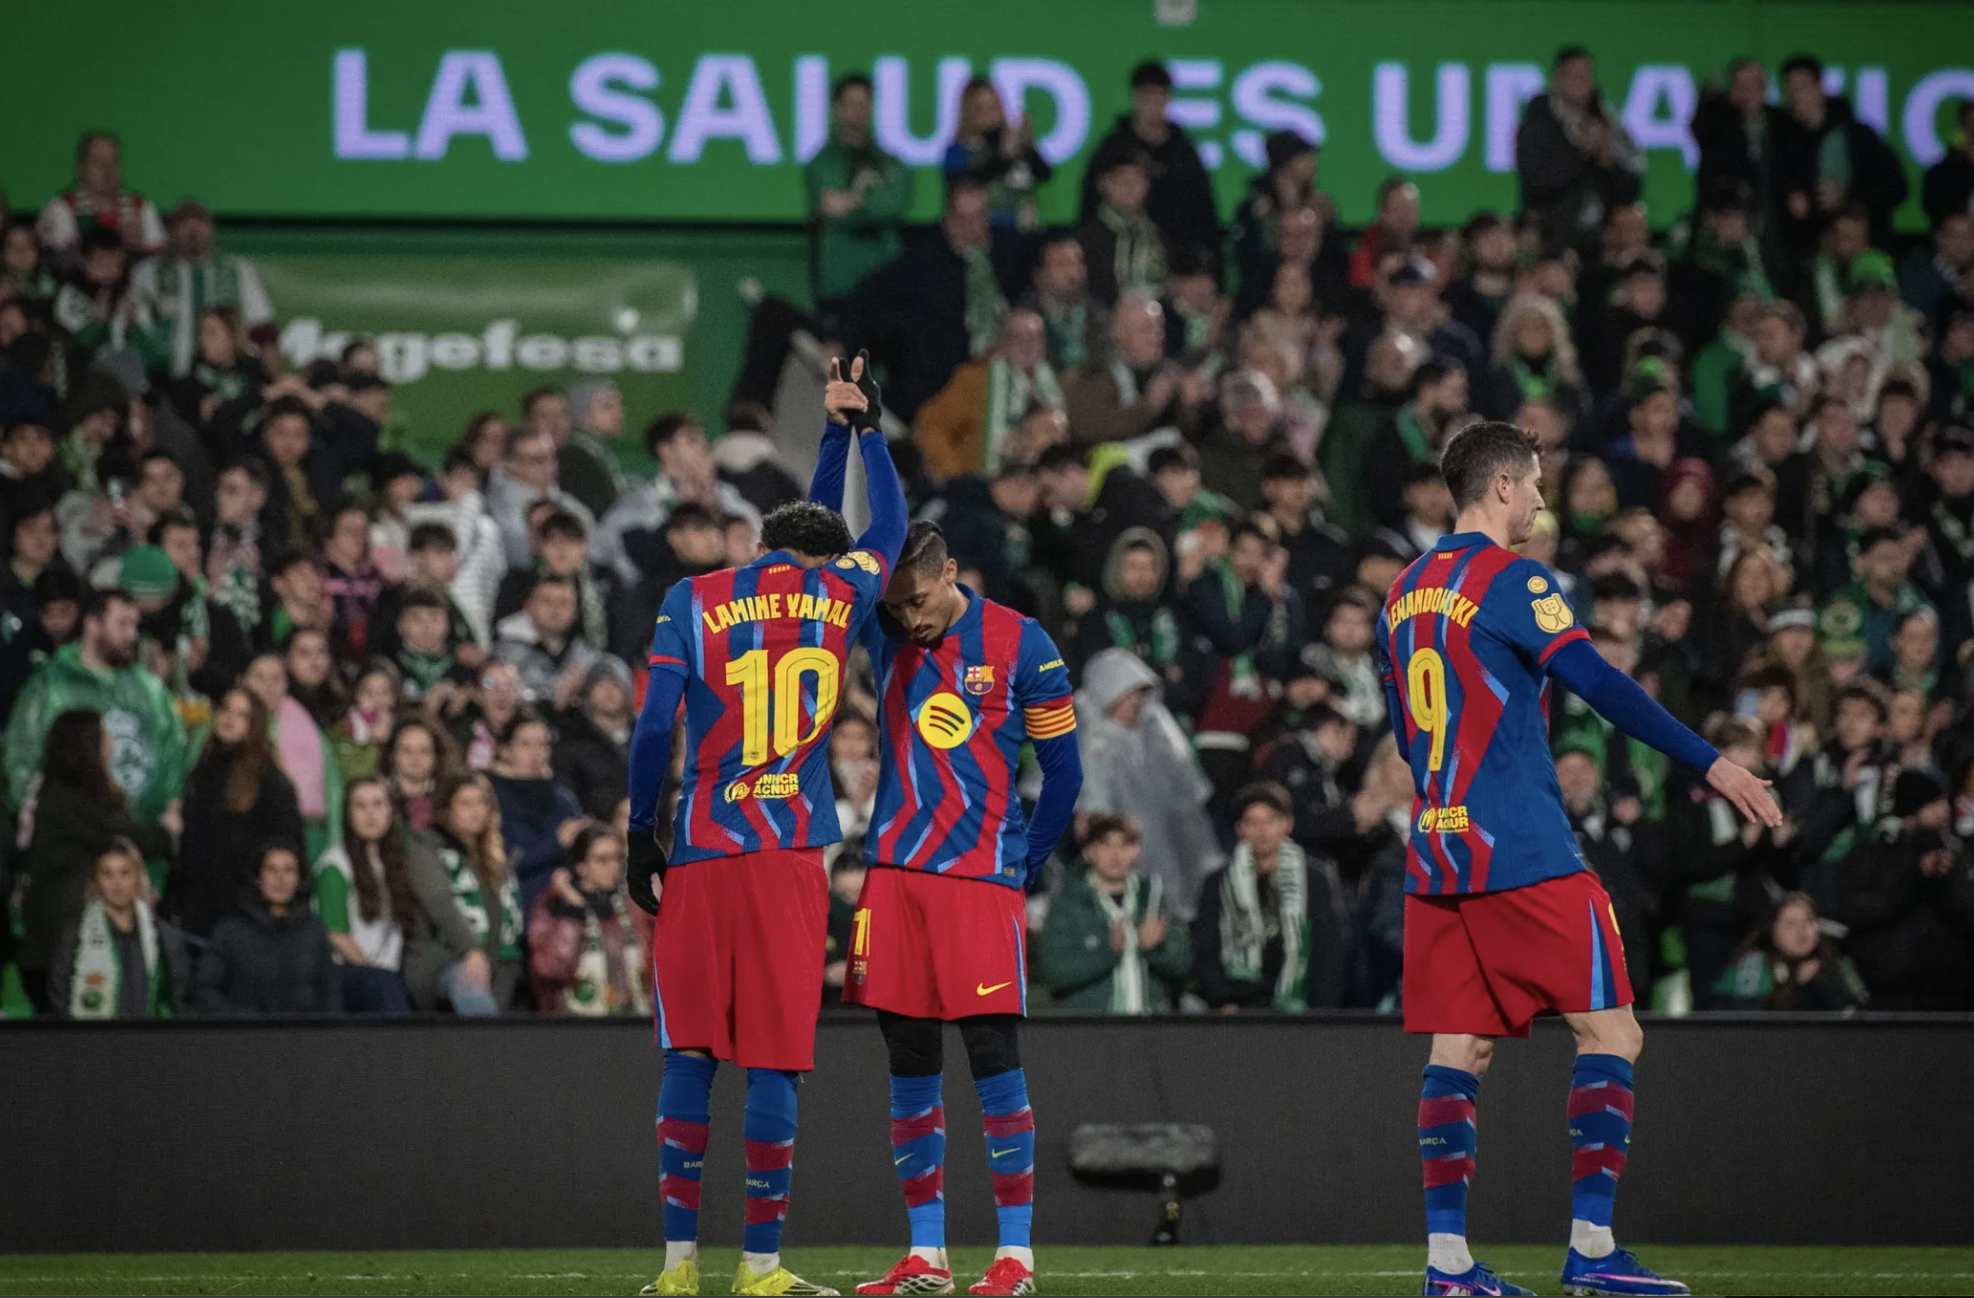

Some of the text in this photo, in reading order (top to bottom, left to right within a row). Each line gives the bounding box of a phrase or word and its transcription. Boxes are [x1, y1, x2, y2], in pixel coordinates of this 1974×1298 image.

[333, 48, 528, 161] LA
[702, 593, 852, 634] LAMINE YAMAL
[725, 647, 839, 766] 10
[1407, 648, 1445, 771] 9
